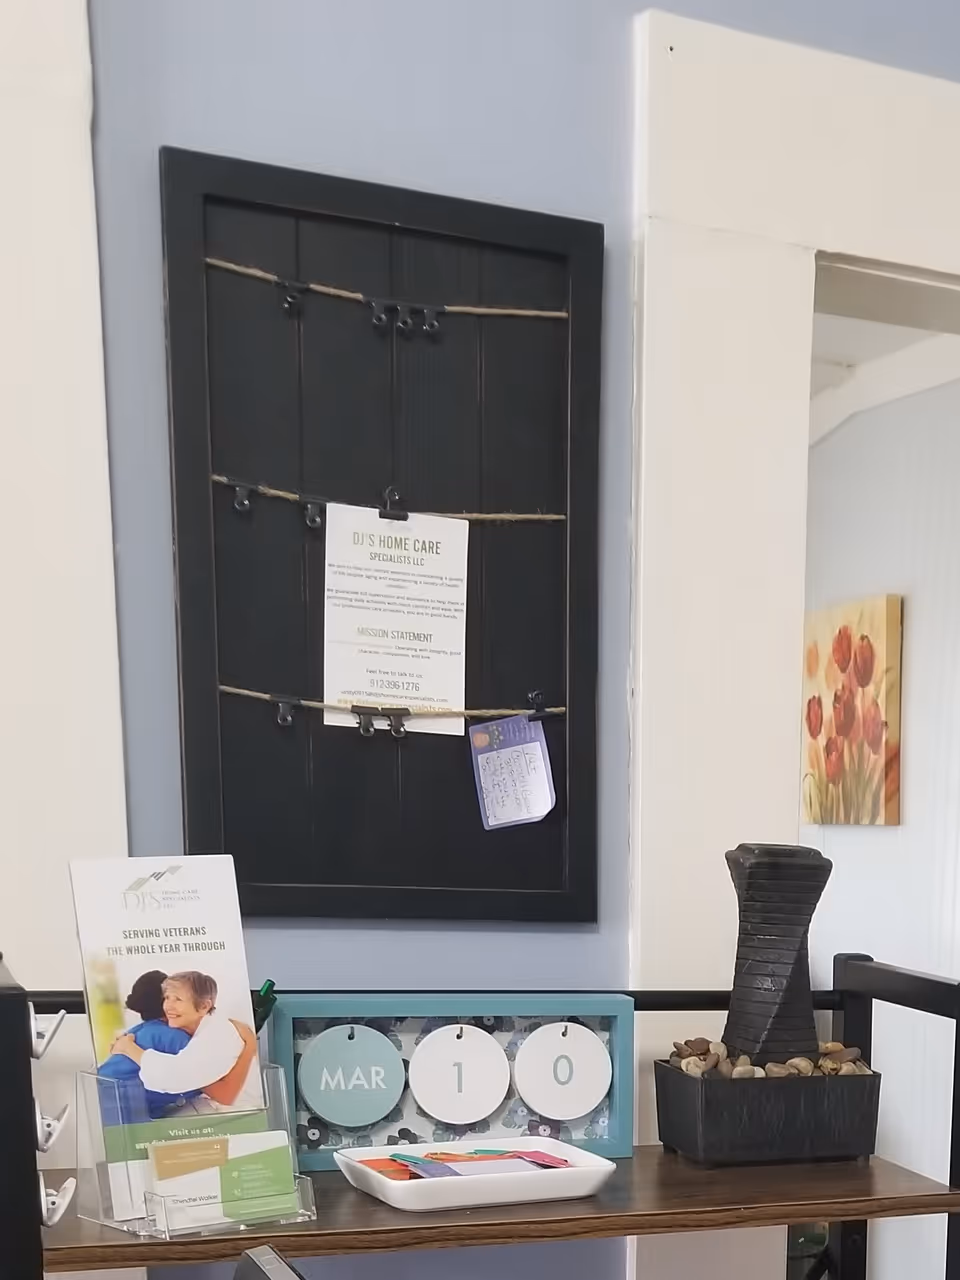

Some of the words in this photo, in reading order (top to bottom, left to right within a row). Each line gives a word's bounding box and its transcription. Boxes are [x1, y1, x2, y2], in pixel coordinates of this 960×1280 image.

[379, 534, 409, 551] HOME
[413, 538, 441, 555] CARE
[369, 551, 412, 566] SPECIALISTS
[412, 556, 425, 567] LLC
[390, 630, 433, 643] STATEMENT
[122, 928, 160, 940] SERVING
[162, 926, 207, 938] VETERANS
[106, 946, 124, 956] THE
[126, 944, 156, 956] WHOLE
[158, 943, 181, 953] YEAR
[182, 941, 226, 952] THROUGH
[452, 1061, 463, 1094] 1
[552, 1054, 574, 1086] 0
[320, 1066, 387, 1092] MAR
[168, 1128, 190, 1137] Visit
